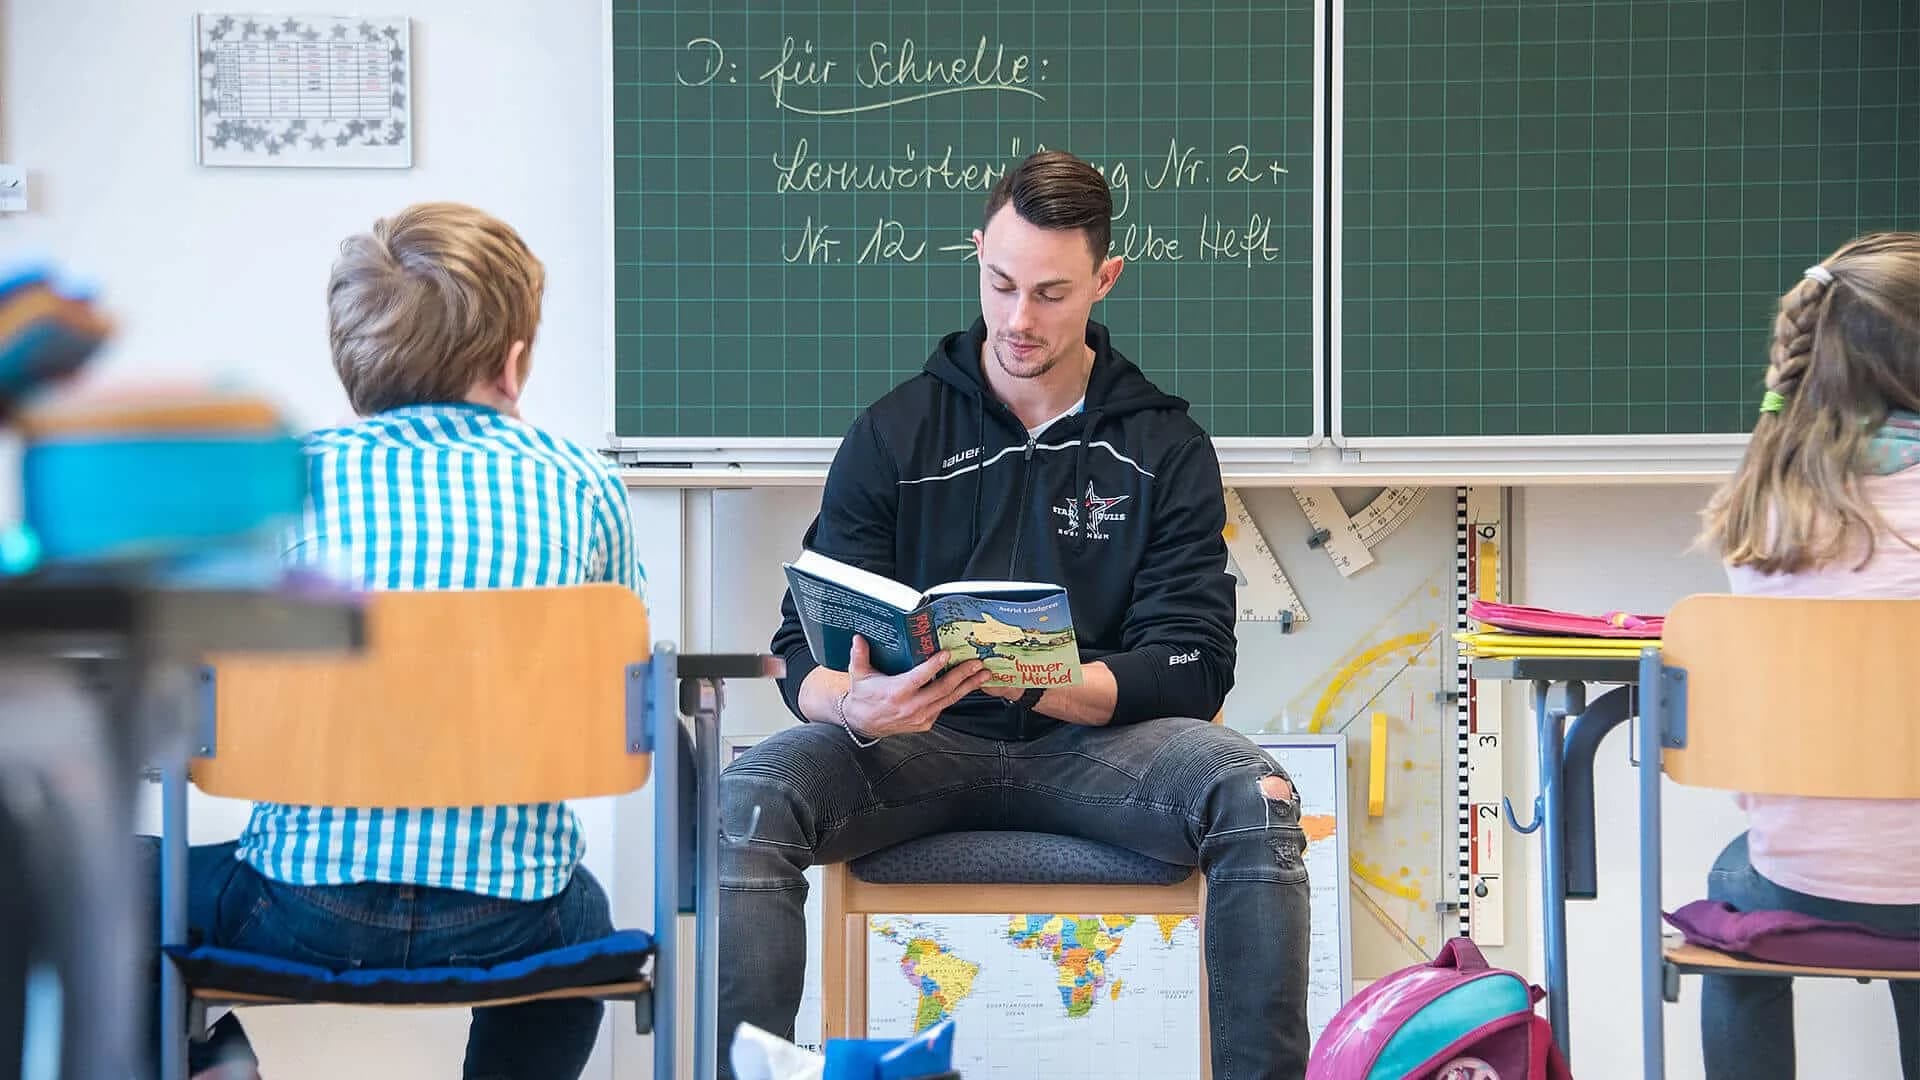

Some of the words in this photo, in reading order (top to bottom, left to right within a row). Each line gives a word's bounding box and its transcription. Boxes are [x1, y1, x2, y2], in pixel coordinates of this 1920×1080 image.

[760, 36, 837, 108] für
[857, 35, 1049, 89] Schnelle:
[1145, 138, 1210, 190] Nr.
[783, 216, 841, 264] Nr.
[858, 217, 928, 264] 12
[1200, 212, 1280, 268] Heft
[1478, 526, 1496, 539] 6
[1015, 659, 1064, 672] Immer
[1021, 668, 1072, 685] Michel
[1479, 735, 1497, 748] 3
[1479, 806, 1499, 819] 2
